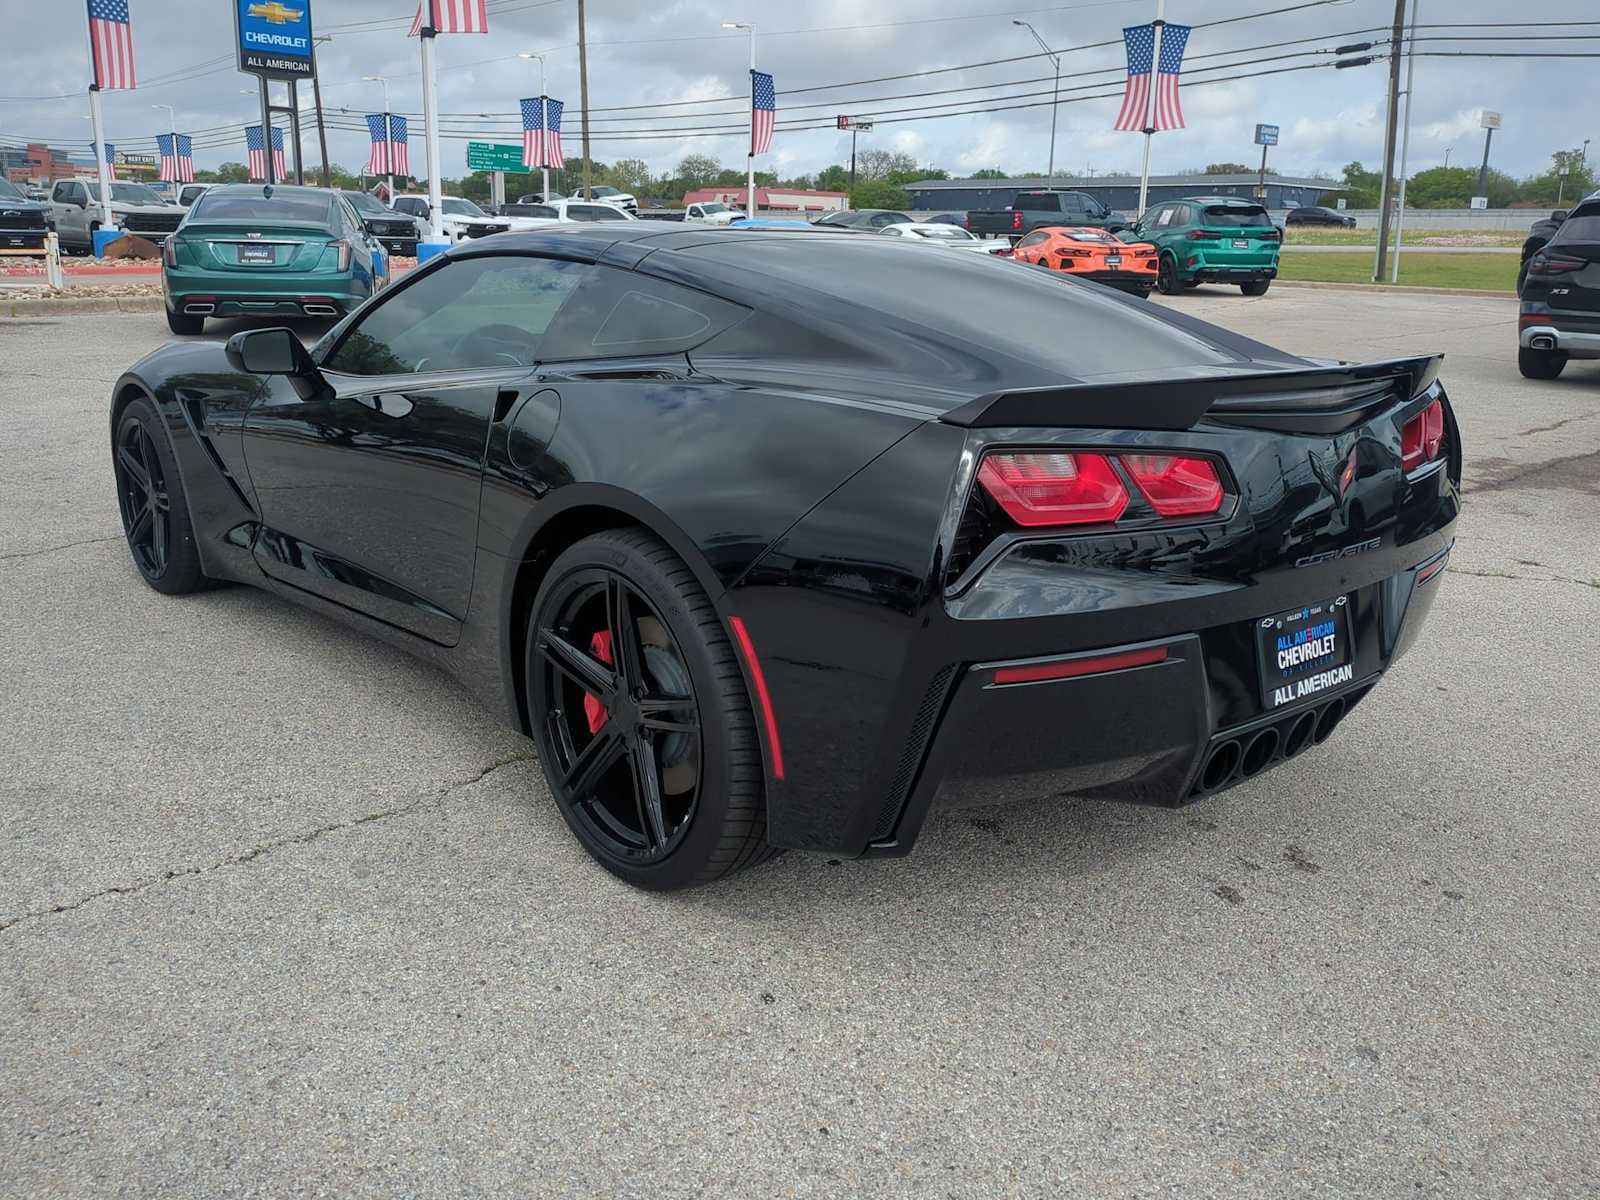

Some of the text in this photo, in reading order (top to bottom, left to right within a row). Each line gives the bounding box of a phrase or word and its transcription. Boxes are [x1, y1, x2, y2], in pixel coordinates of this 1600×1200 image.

[245, 31, 307, 48] CHEVROLET
[247, 56, 310, 72] ALL AMERICAN
[1295, 536, 1381, 568] CORVETTE
[1277, 621, 1335, 650] ALL AMERICAN
[1278, 634, 1335, 670] CHEVROLET
[1274, 664, 1353, 706] ALL AMERICAN
